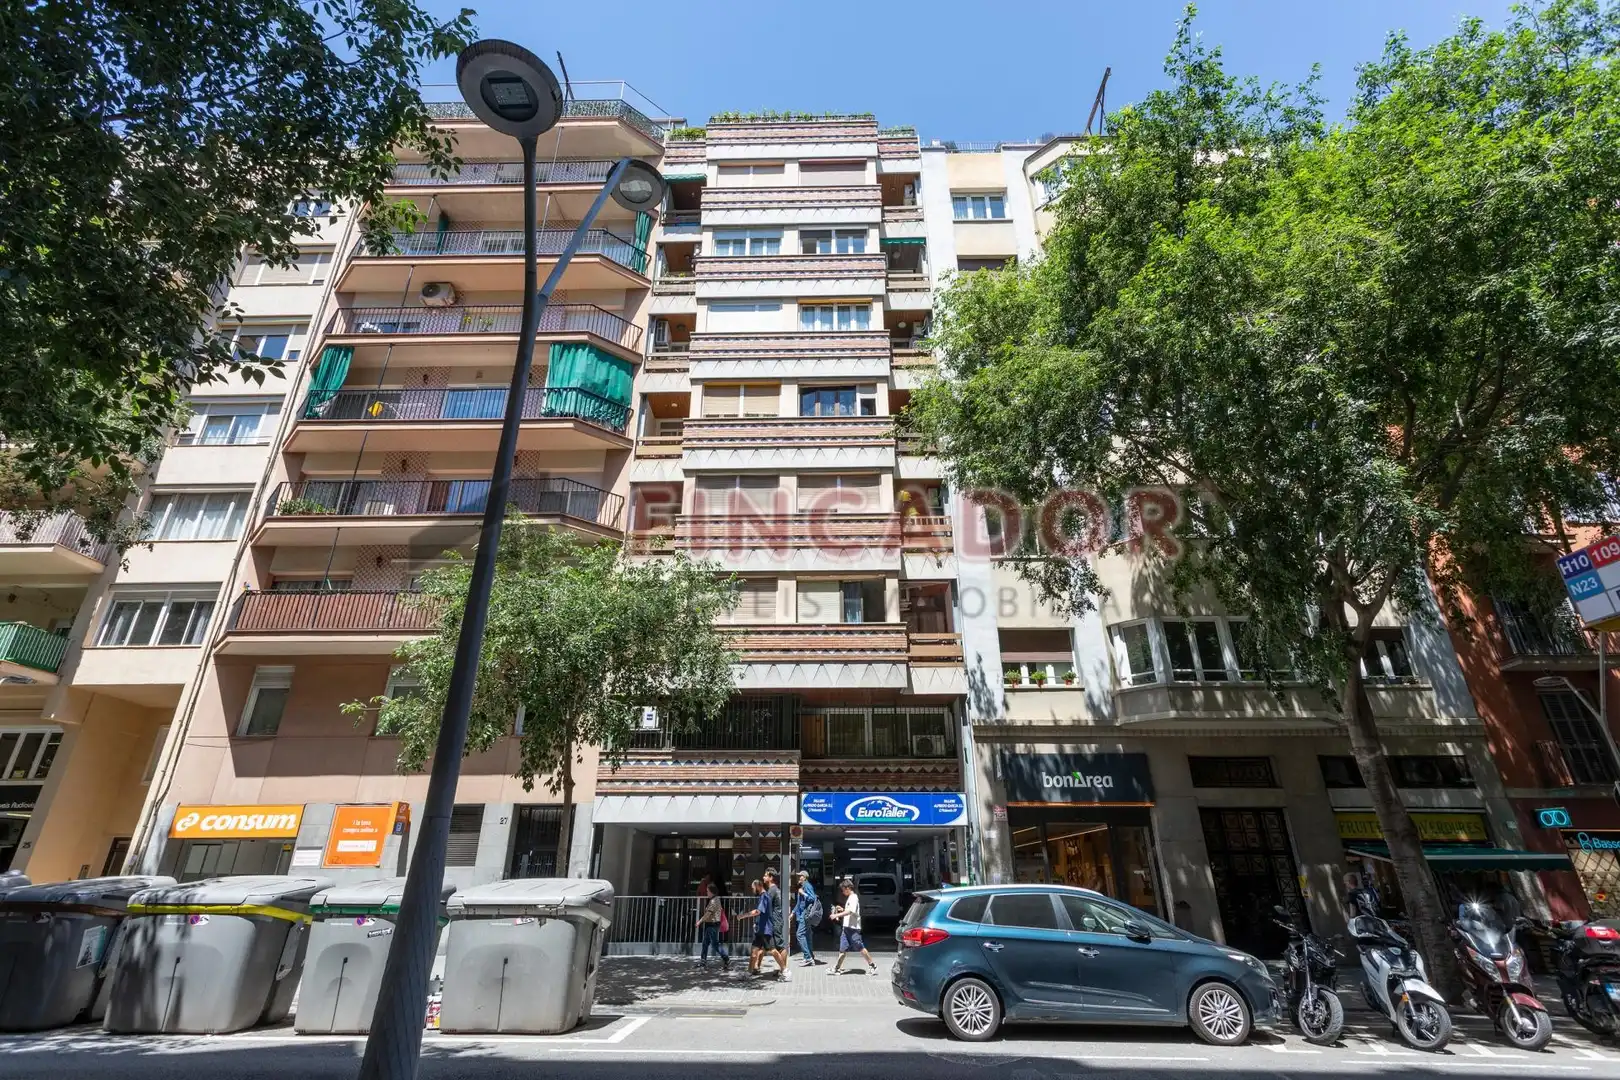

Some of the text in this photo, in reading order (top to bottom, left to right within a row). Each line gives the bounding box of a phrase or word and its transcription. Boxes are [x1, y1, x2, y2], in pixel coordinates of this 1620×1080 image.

[1560, 542, 1620, 575] H10 109
[1570, 577, 1598, 595] N23
[499, 817, 508, 825] 27
[857, 806, 909, 818] EuroTaller
[200, 813, 297, 832] consum
